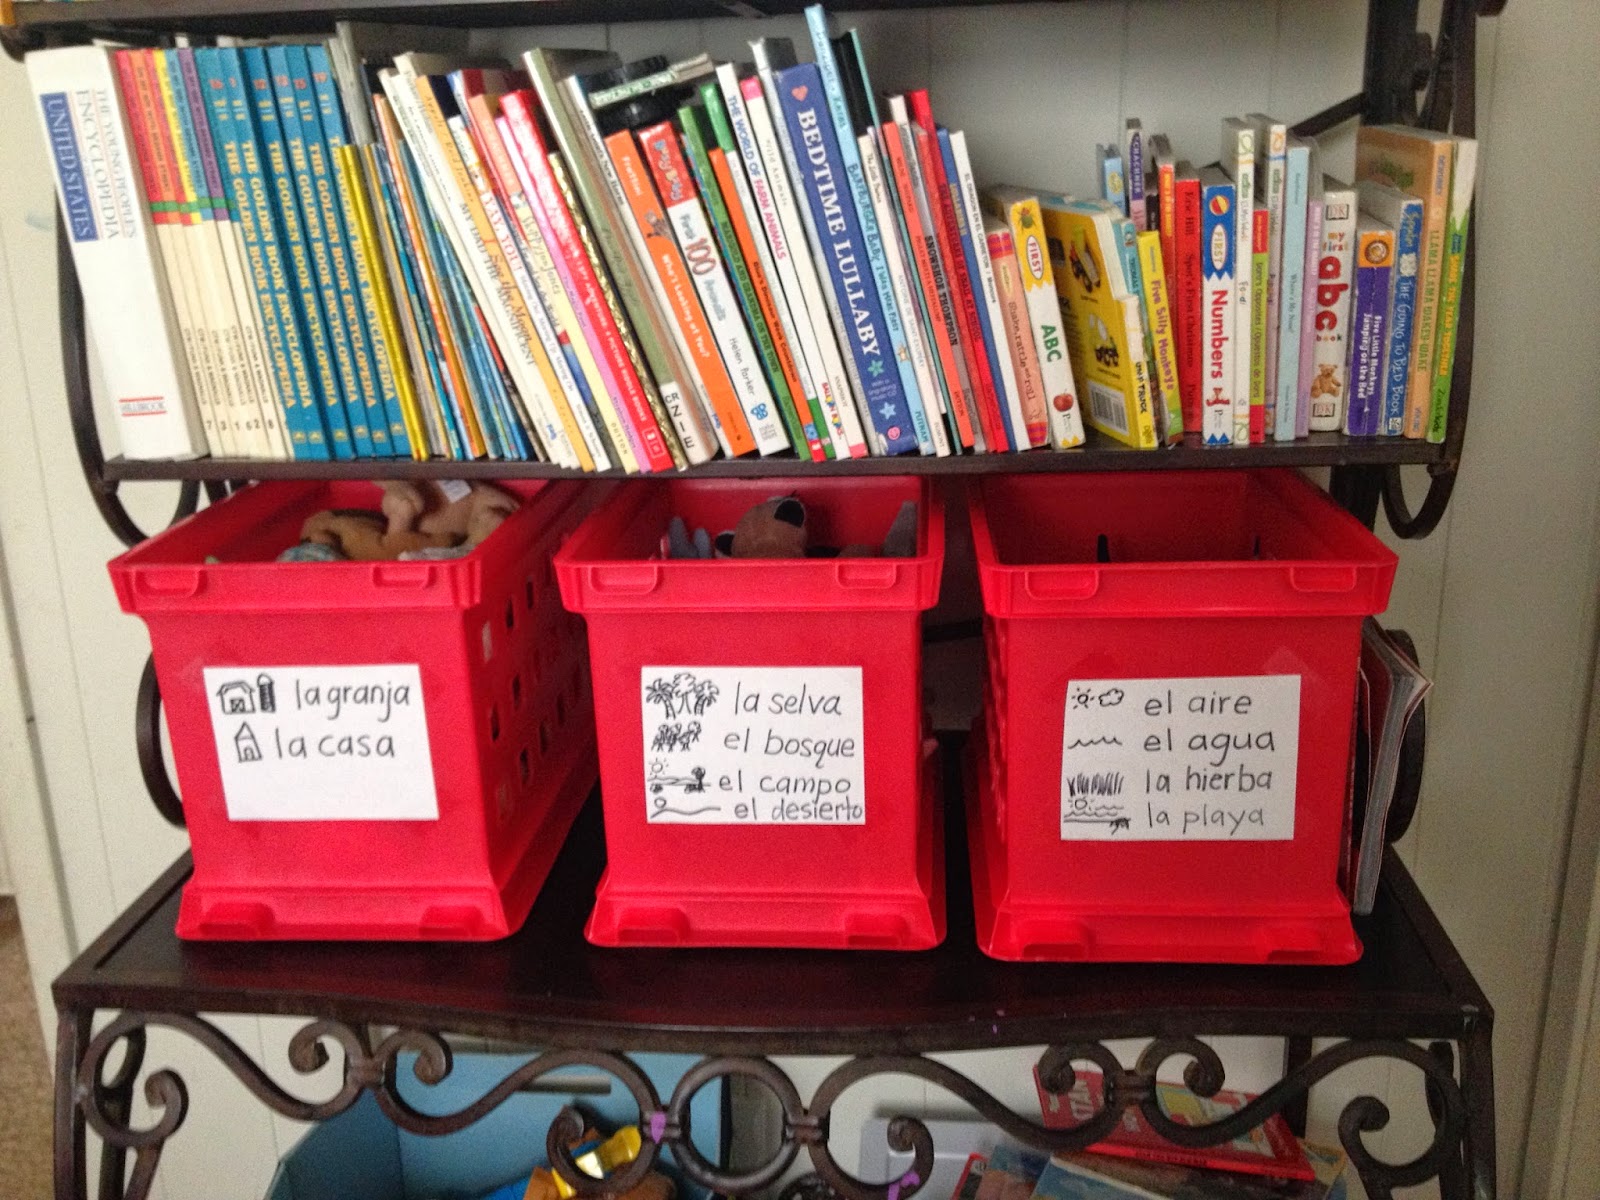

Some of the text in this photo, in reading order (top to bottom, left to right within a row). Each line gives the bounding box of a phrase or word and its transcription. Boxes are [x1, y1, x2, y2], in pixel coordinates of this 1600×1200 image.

[45, 96, 93, 237] UNITED STATES
[78, 88, 120, 239] ENCYCLOPEDIA
[307, 141, 326, 176] THE
[725, 94, 787, 261] THE WORLD OF FARM ANIMALS
[315, 177, 341, 244] GOLDEN
[678, 212, 698, 243] First
[480, 195, 506, 234] YAY,
[499, 233, 525, 276] YOU!
[681, 234, 720, 280] 100
[794, 107, 847, 236] BEDTIME
[831, 238, 882, 361] LULLABY
[965, 182, 978, 213] DRAGON
[985, 275, 998, 304] Moncure
[1028, 240, 1042, 274] FIRST
[1214, 231, 1224, 264] FIRST
[1327, 231, 1345, 243] my
[223, 140, 296, 409] THE GOLDEN BOOK ENCYCLOPEDIA
[240, 139, 313, 408] THE GOLDEN BOOK ENCYCLOPEDIA
[267, 140, 338, 407] THE GOLDEN BOOK ENCYCLOPEDIA
[288, 137, 359, 404] THE GOLDEN BOOK ENCYCLOPEDIA
[330, 244, 351, 291] BOOK
[457, 201, 537, 367] MY DAD THE MAGNIFICENT
[659, 251, 680, 283] Who's
[1182, 190, 1195, 368] Eric Hill Spot's First Christmas
[1423, 229, 1440, 303] LLAMA LLAMA
[488, 251, 535, 342] See the Moon
[673, 282, 696, 323] Looking
[734, 262, 749, 281] AND
[759, 332, 772, 350] THE
[923, 234, 959, 347] SNOWSHOE THOMPSON
[1149, 278, 1165, 304] Five
[688, 319, 703, 336] at
[751, 260, 799, 383] Blue's Dinosaur Week Countdown
[1151, 305, 1171, 335] Silly
[1210, 288, 1228, 379] Numbers
[1442, 305, 1454, 329] YEAR
[341, 291, 378, 409] ENCYCLOPEDIA
[359, 284, 395, 402] ENCYCLOPEDIA
[693, 334, 711, 360] You?
[1039, 320, 1063, 364] ABC
[1157, 337, 1176, 391] Monkeys
[1356, 312, 1372, 399] Jumping on the Bed
[1364, 313, 1382, 397] Five Little Monkeys
[1389, 279, 1413, 415] THE GOING TO BED BOOK
[1438, 330, 1452, 376] TOGETHER
[606, 336, 625, 368] PICTURE
[619, 367, 637, 395] RIDDLE
[631, 395, 648, 422] BOOKS
[727, 335, 759, 398] Helen Parker
[1014, 334, 1036, 401] rattle roll
[1135, 382, 1150, 413] TRUCK
[1411, 405, 1422, 433] VIKING
[609, 420, 629, 456] DUTTON
[913, 410, 930, 443] PUTNAM
[296, 679, 410, 722] la granja
[734, 681, 842, 716] la selva
[1143, 689, 1253, 716] el aire
[275, 727, 395, 759] la casa
[724, 727, 855, 769] el bosque
[1143, 728, 1276, 767] el agua
[718, 769, 851, 803] el campo
[1146, 763, 1273, 794] la hierba
[734, 795, 864, 822] el desierto
[1147, 802, 1265, 836] la playa
